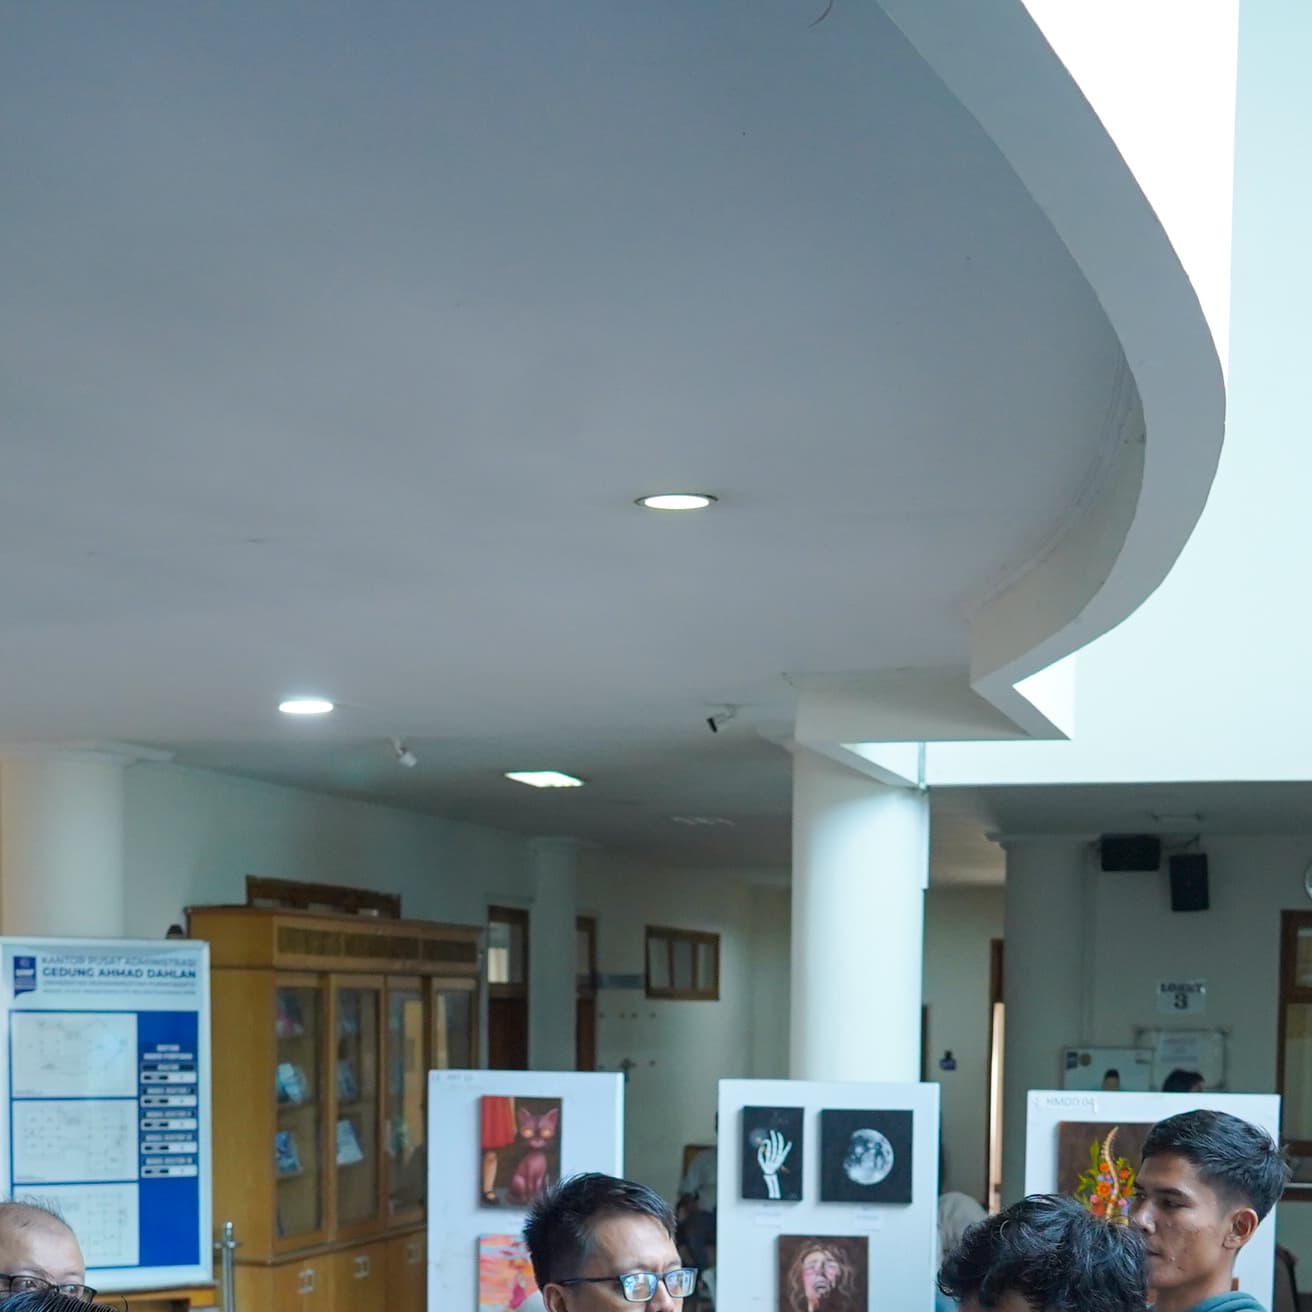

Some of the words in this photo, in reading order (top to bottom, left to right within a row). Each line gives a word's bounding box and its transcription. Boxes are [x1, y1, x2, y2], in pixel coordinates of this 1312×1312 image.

[42, 967, 94, 977] GEDUNG
[98, 967, 143, 978] AHMAD
[147, 967, 197, 978] DAHLAN
[1174, 993, 1188, 1010] 3
